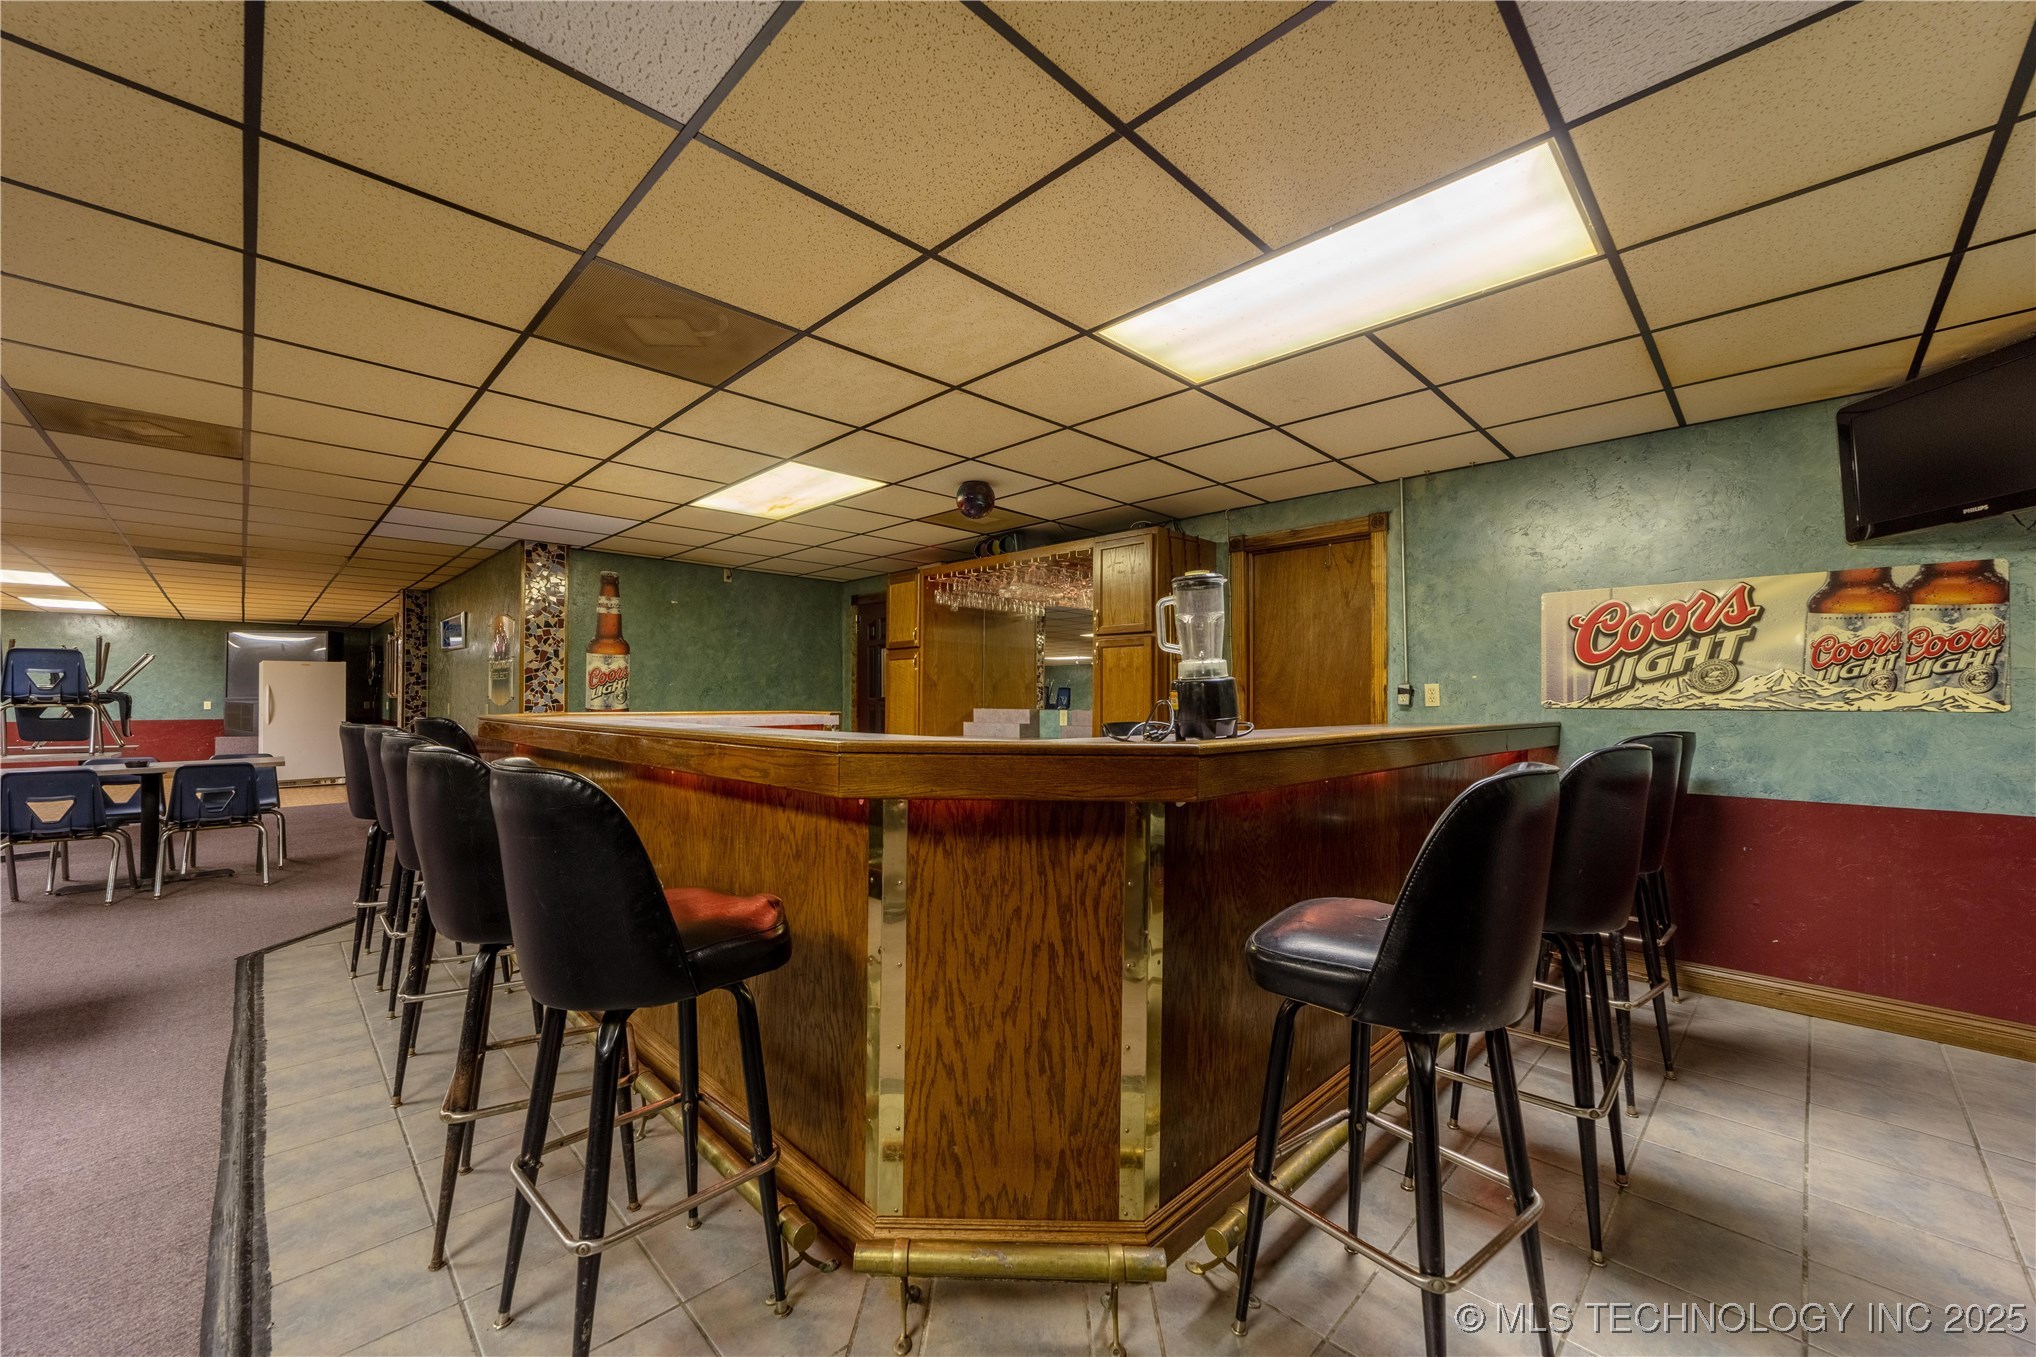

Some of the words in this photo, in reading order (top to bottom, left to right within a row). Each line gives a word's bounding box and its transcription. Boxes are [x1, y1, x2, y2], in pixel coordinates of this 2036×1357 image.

[1962, 504, 1989, 514] PHILIPS
[1570, 582, 1762, 667] Coors
[1905, 622, 2005, 664] Coors
[1589, 628, 1757, 701] LIGHT
[1810, 629, 1903, 670] Coors
[1815, 652, 1900, 684] LIGHT
[1905, 646, 2002, 683] LIGHT
[588, 666, 629, 688] Coors
[591, 679, 628, 700] LIGHT
